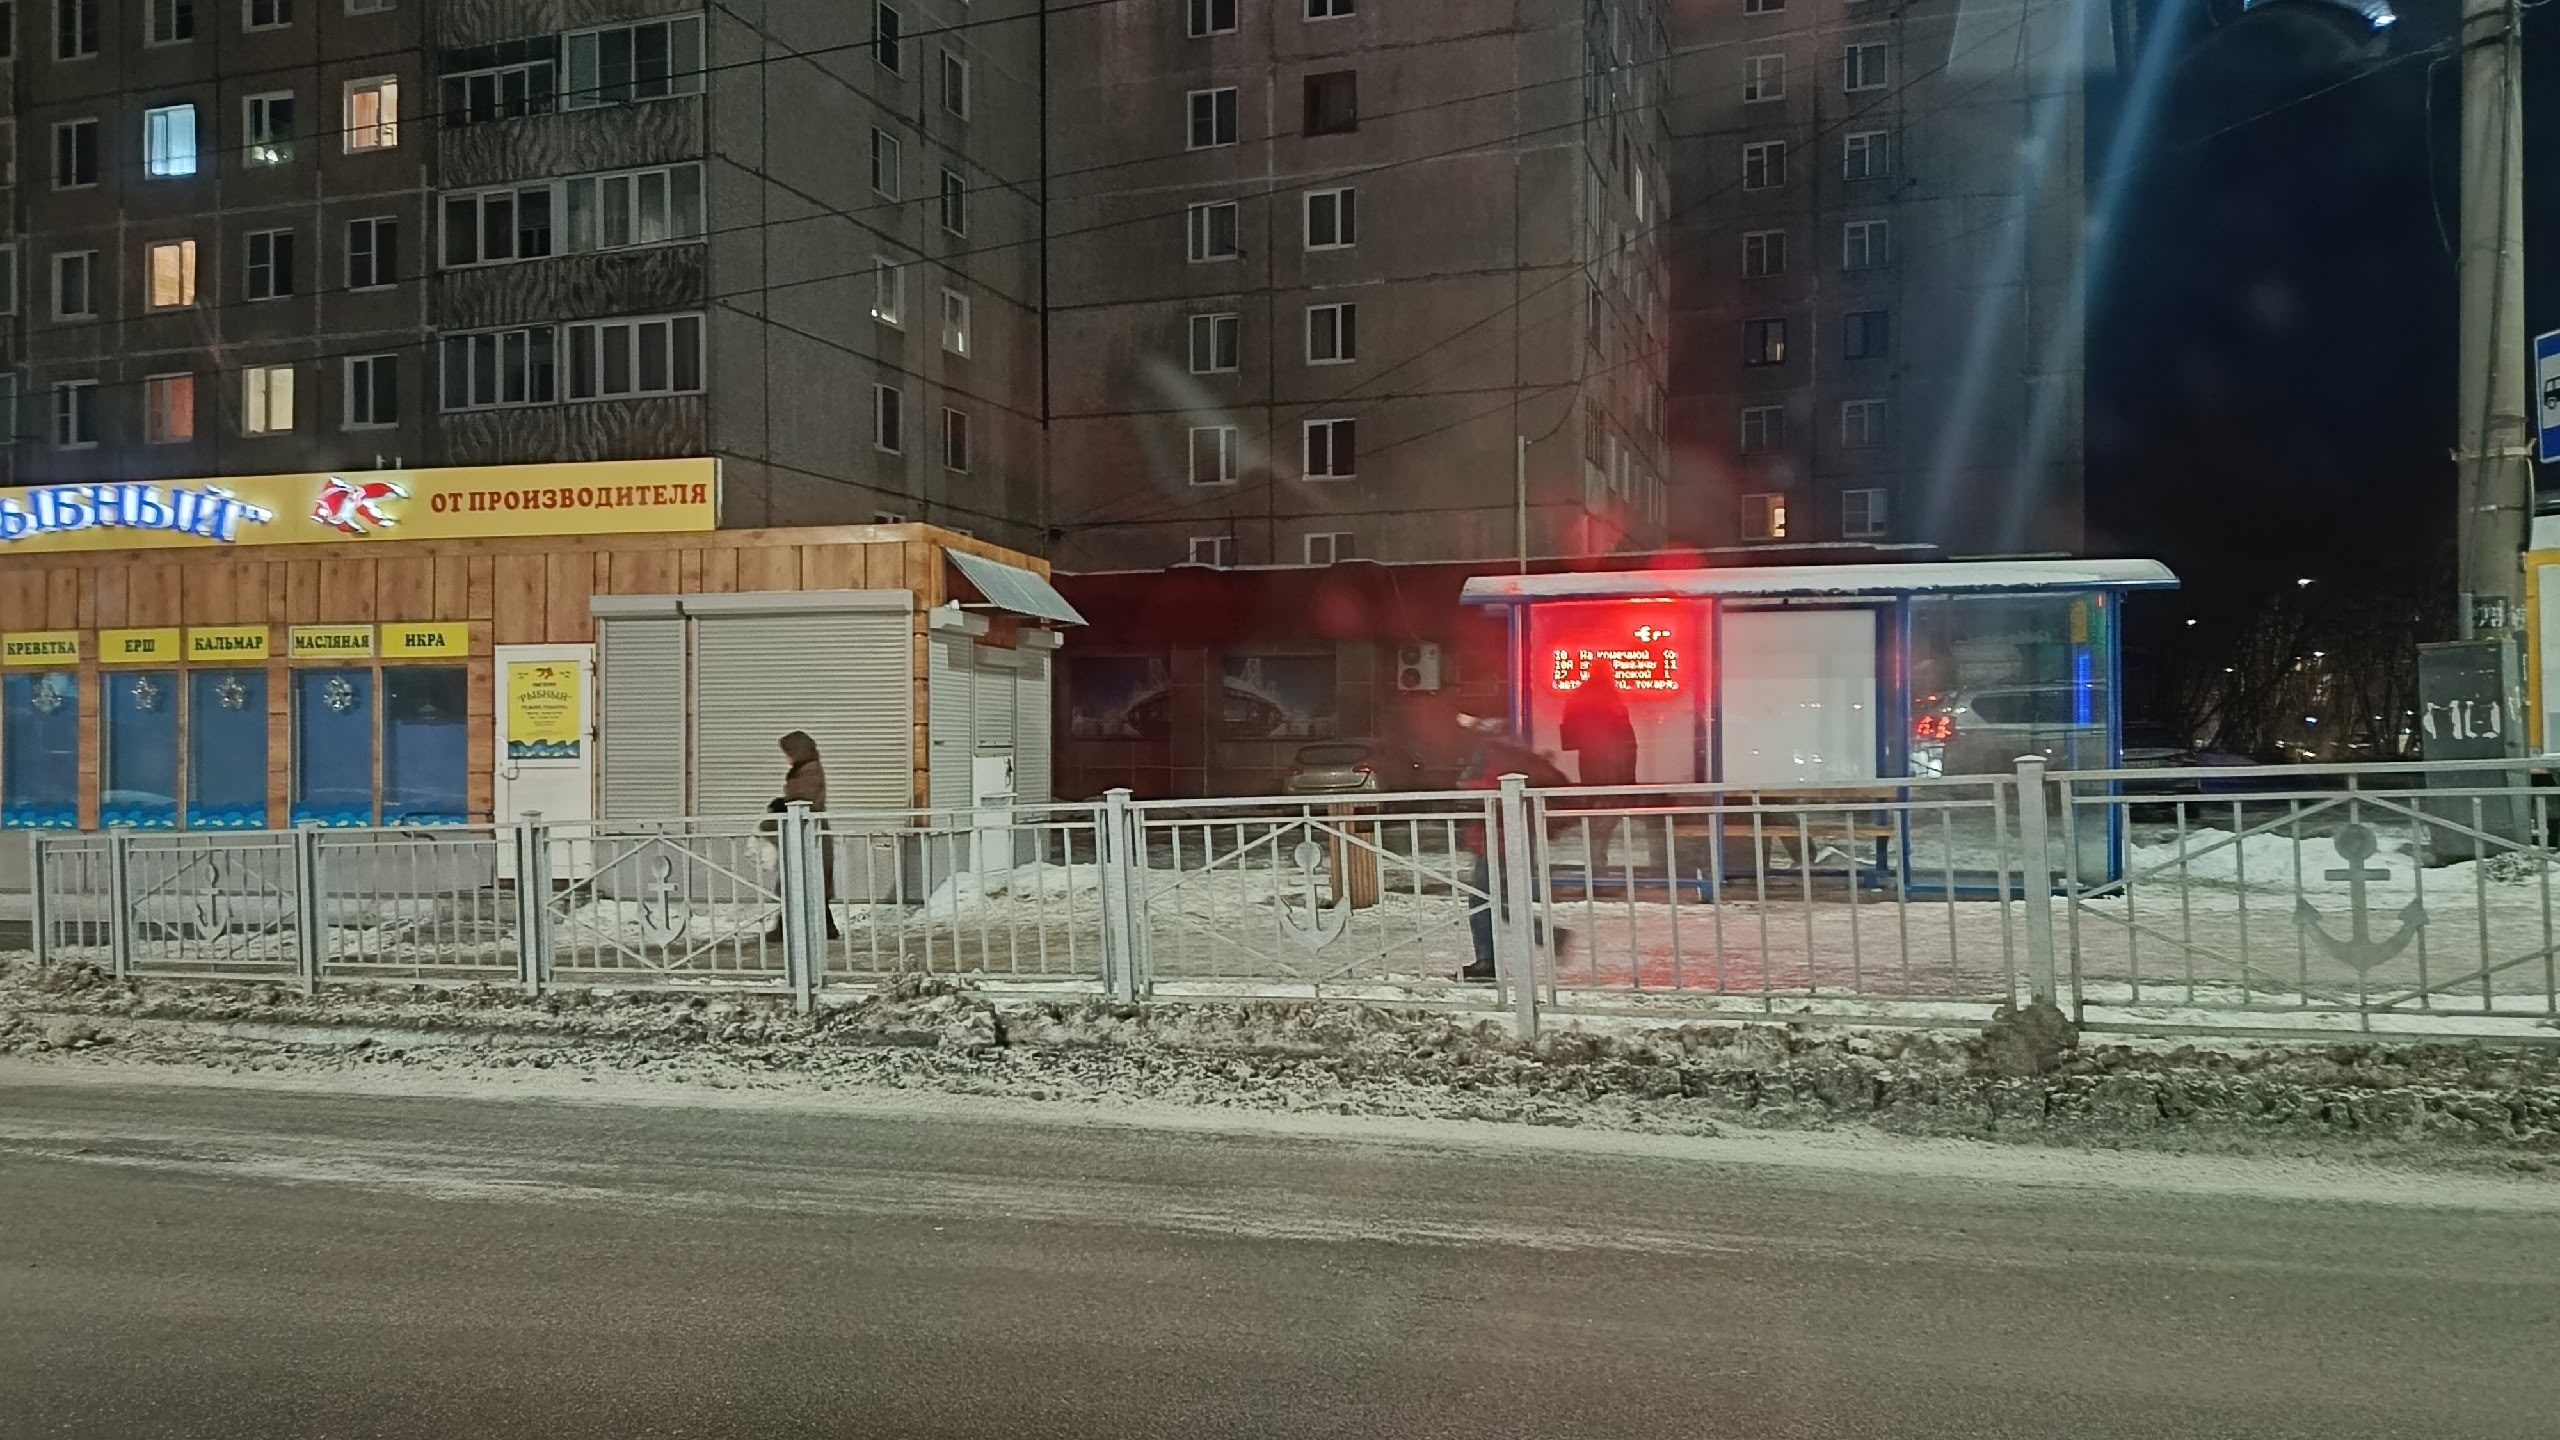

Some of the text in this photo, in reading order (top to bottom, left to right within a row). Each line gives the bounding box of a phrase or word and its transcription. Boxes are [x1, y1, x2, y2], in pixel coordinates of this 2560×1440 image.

[431, 483, 707, 513] ОТ ПРОИЗВОДИТЕЛЯ
[7, 640, 76, 656] КРЕВЕТКА
[124, 638, 156, 653] ЕРШ
[195, 636, 263, 651] КАЛЬМАР
[295, 635, 370, 649] МАСЛЯНАЯ
